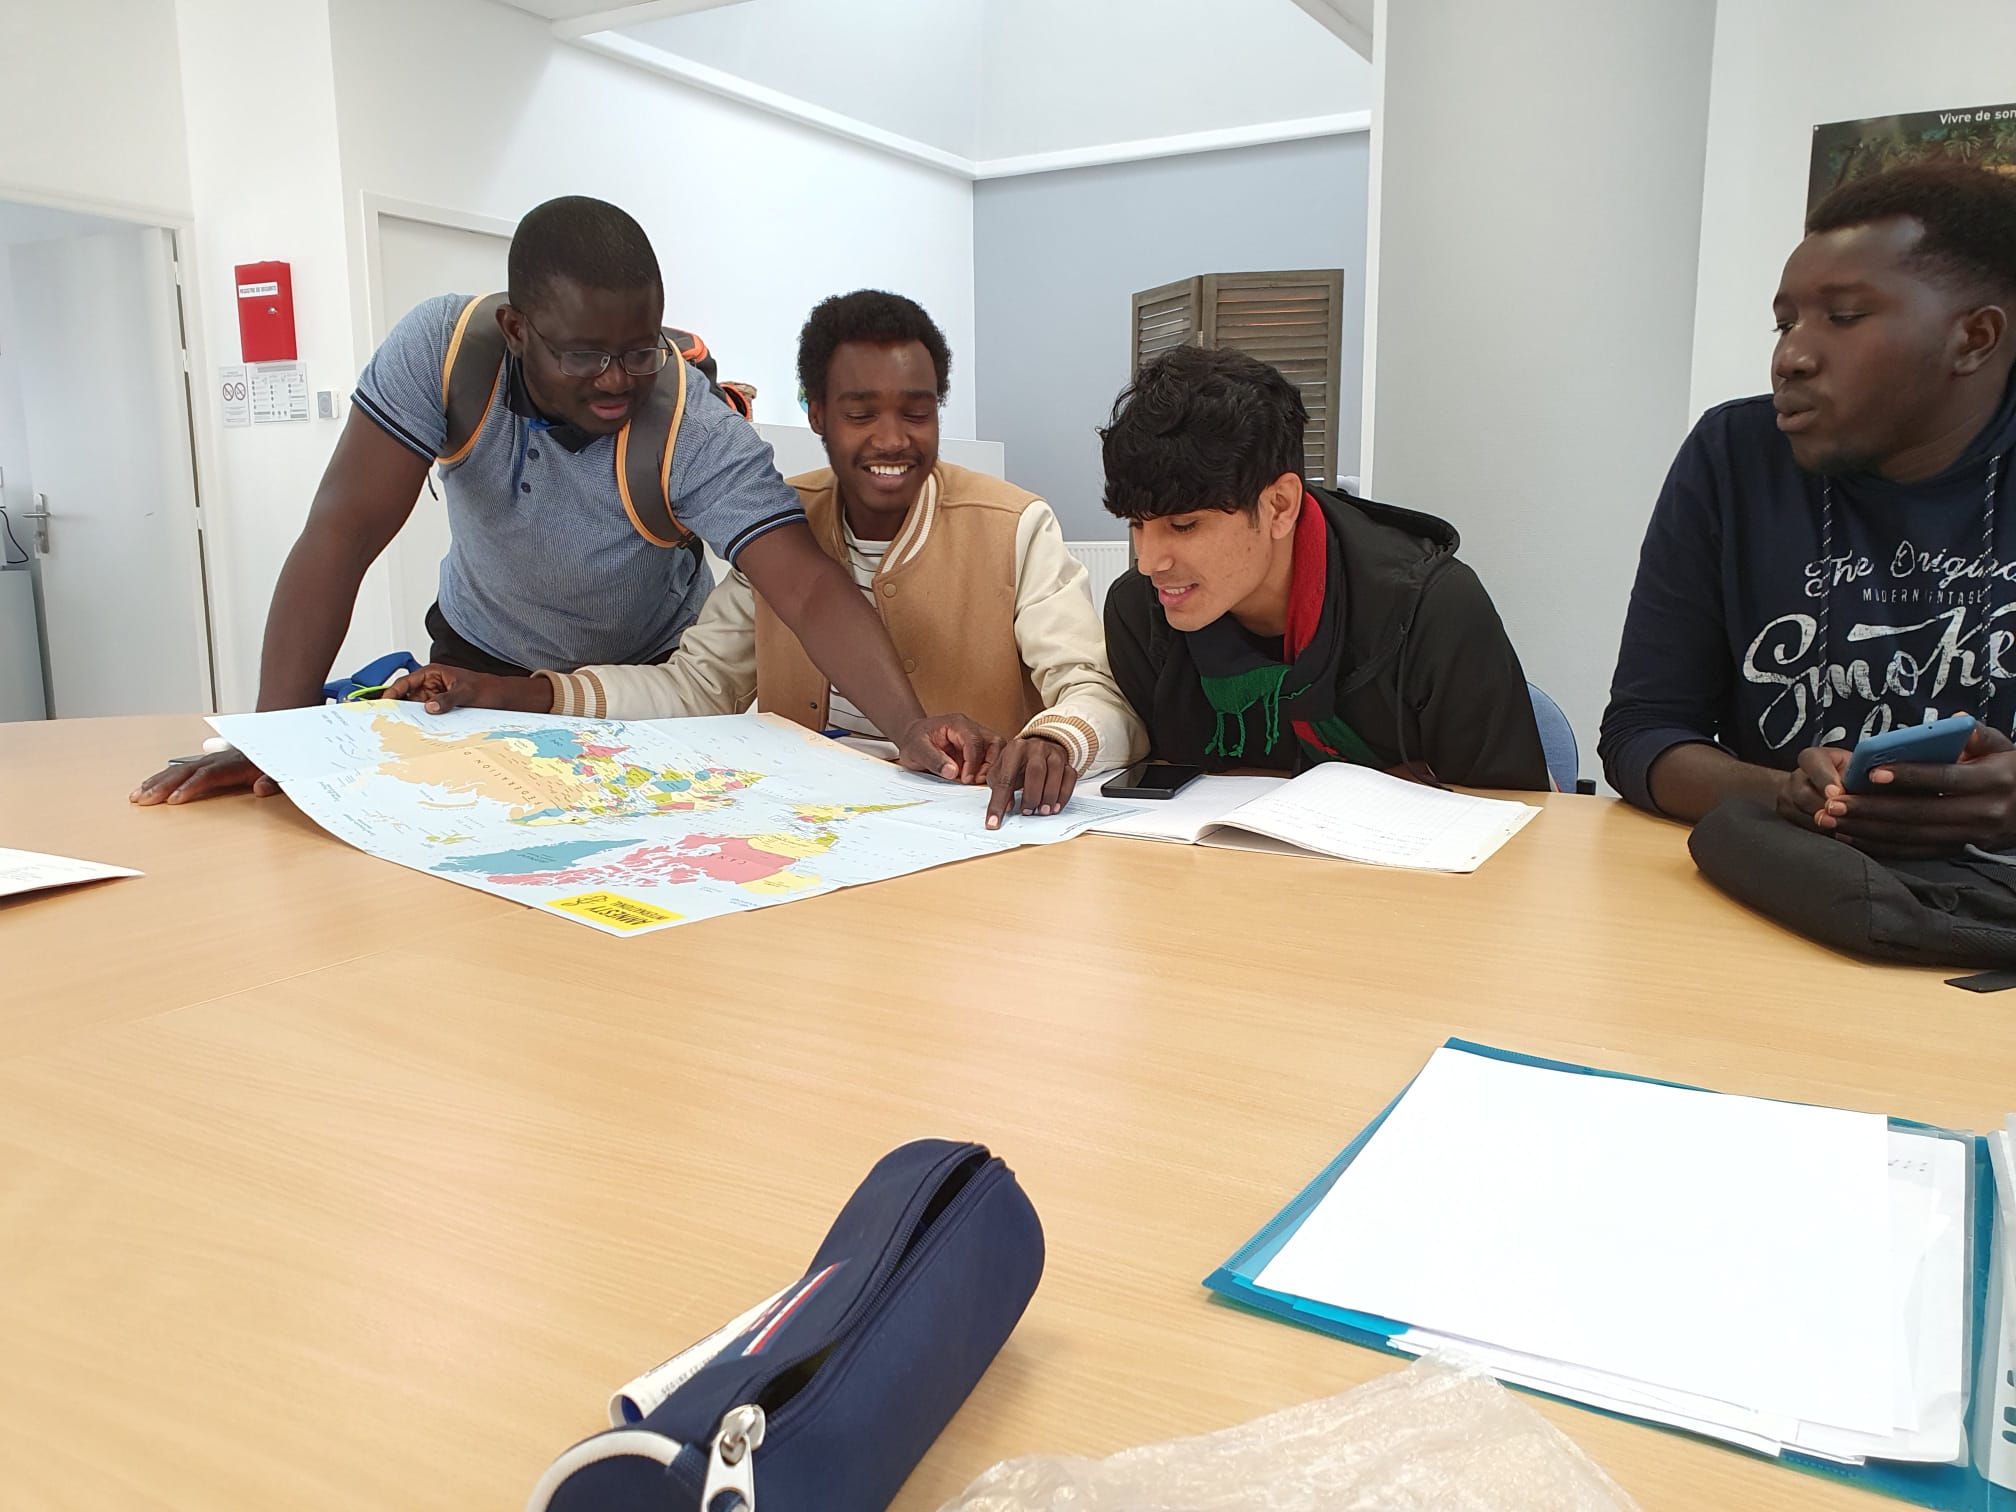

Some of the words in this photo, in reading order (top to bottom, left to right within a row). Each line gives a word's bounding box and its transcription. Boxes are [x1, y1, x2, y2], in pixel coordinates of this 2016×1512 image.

[1939, 112, 1972, 125] Vivre
[1975, 109, 1991, 122] de
[1804, 550, 1874, 597] The
